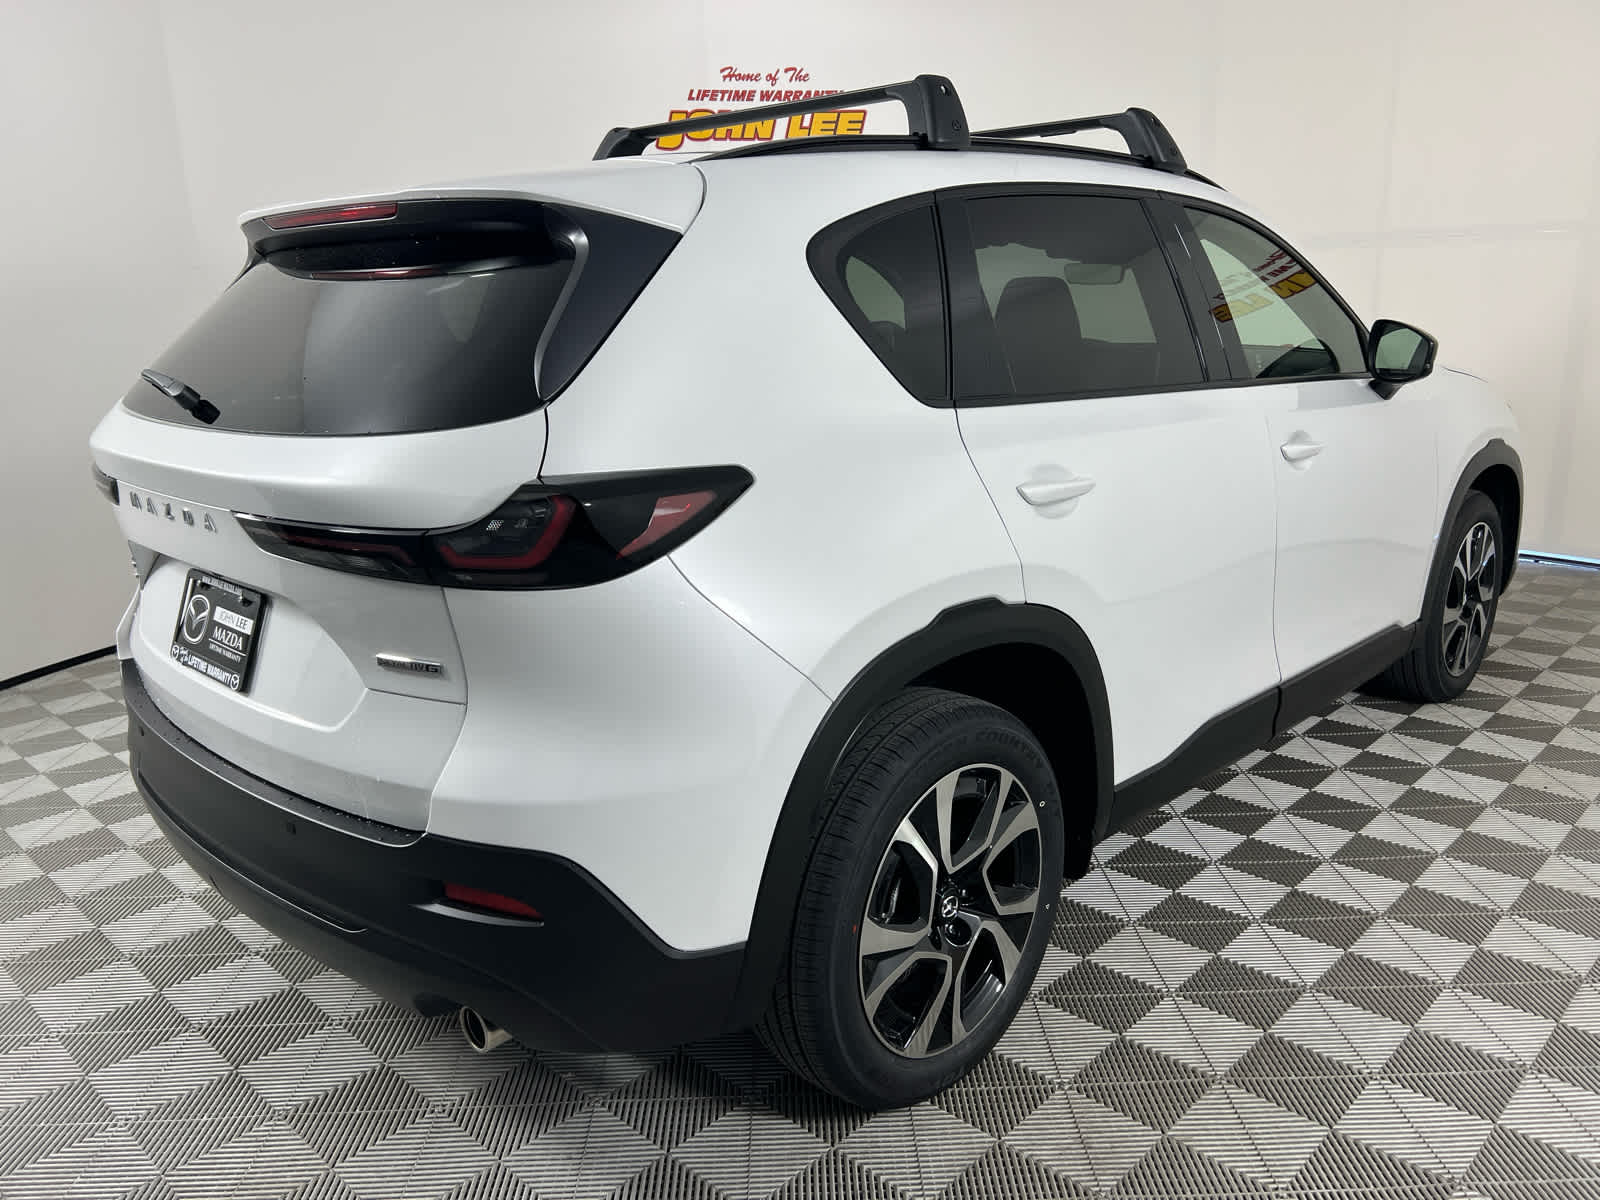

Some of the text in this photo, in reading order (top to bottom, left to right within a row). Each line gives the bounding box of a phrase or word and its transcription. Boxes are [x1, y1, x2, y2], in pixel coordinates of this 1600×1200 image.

[719, 66, 810, 86] Home of The
[687, 89, 756, 102] LIFETIME
[656, 109, 867, 150] JOHN LEE
[129, 491, 217, 534] MAZDA
[235, 617, 248, 631] LEE
[212, 626, 243, 650] MAZDA
[188, 654, 232, 685] LIFETIME WARRANTY
